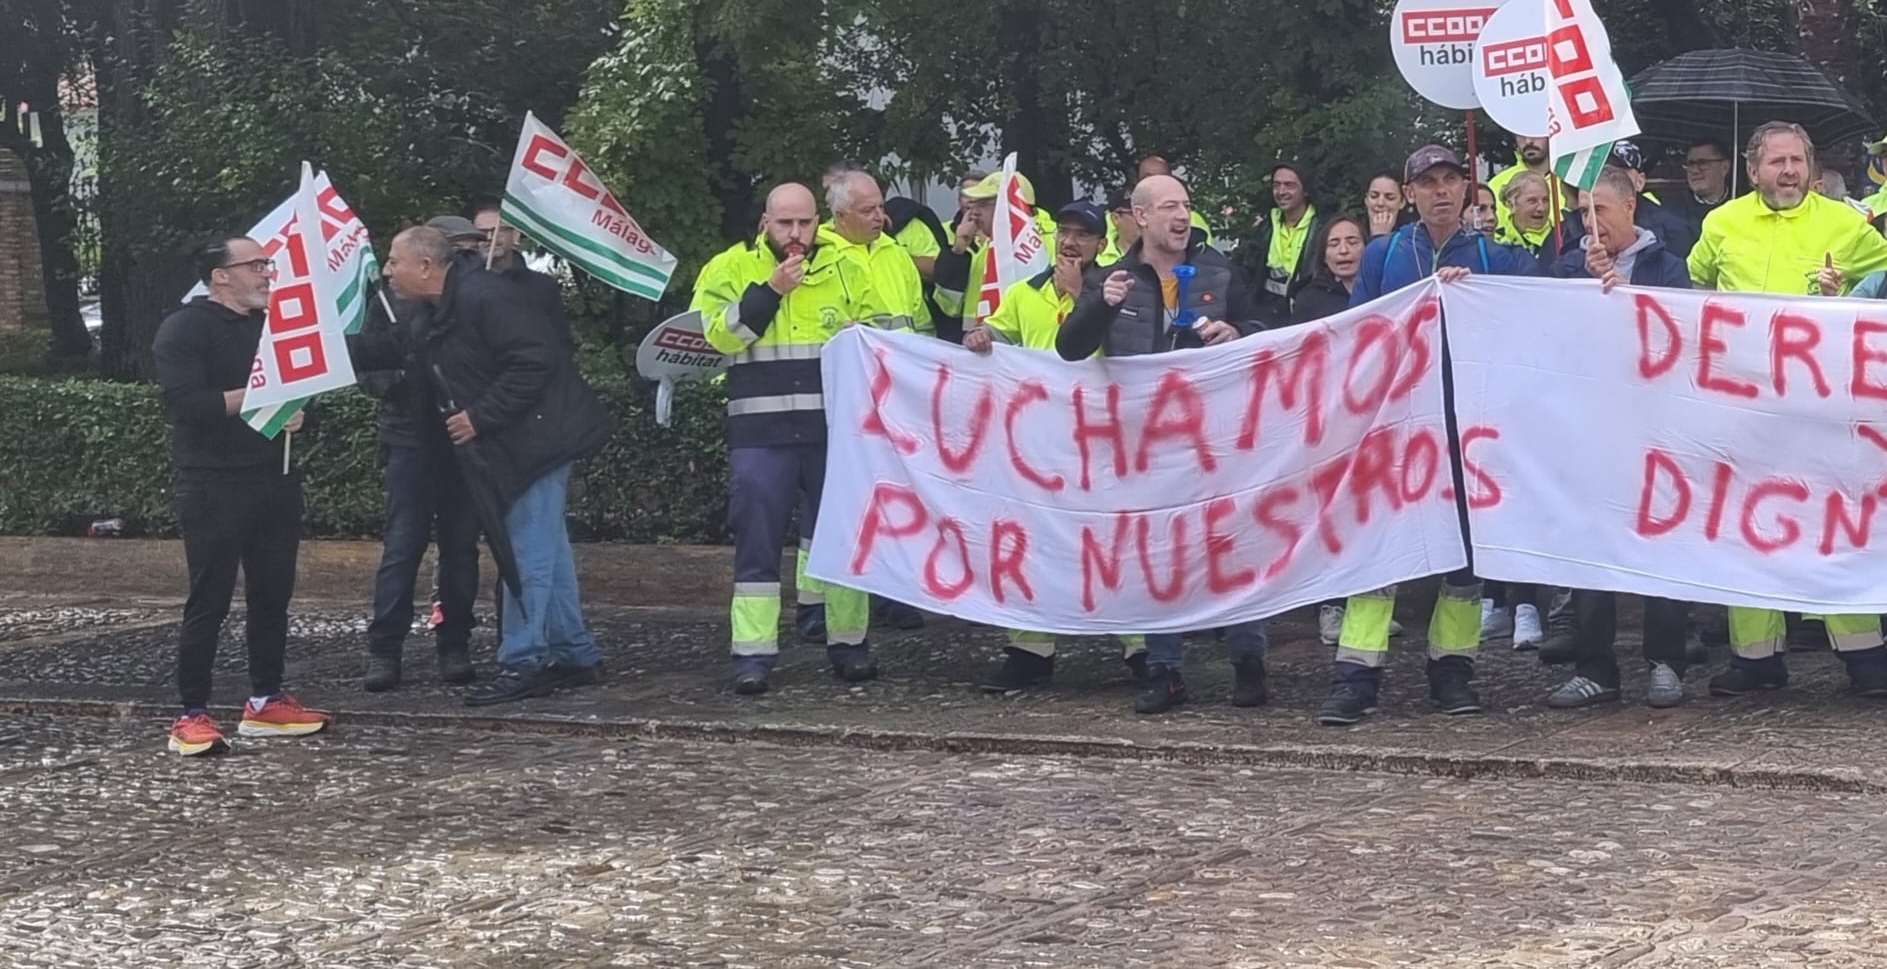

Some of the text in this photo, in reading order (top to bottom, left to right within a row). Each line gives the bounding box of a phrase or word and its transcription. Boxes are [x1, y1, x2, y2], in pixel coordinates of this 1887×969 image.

[1408, 15, 1484, 37] CCOO
[1488, 42, 1547, 71] CCO
[656, 349, 723, 368] hábitat
[863, 297, 1439, 491] LUCHAMOS
[852, 480, 1034, 605] POR
